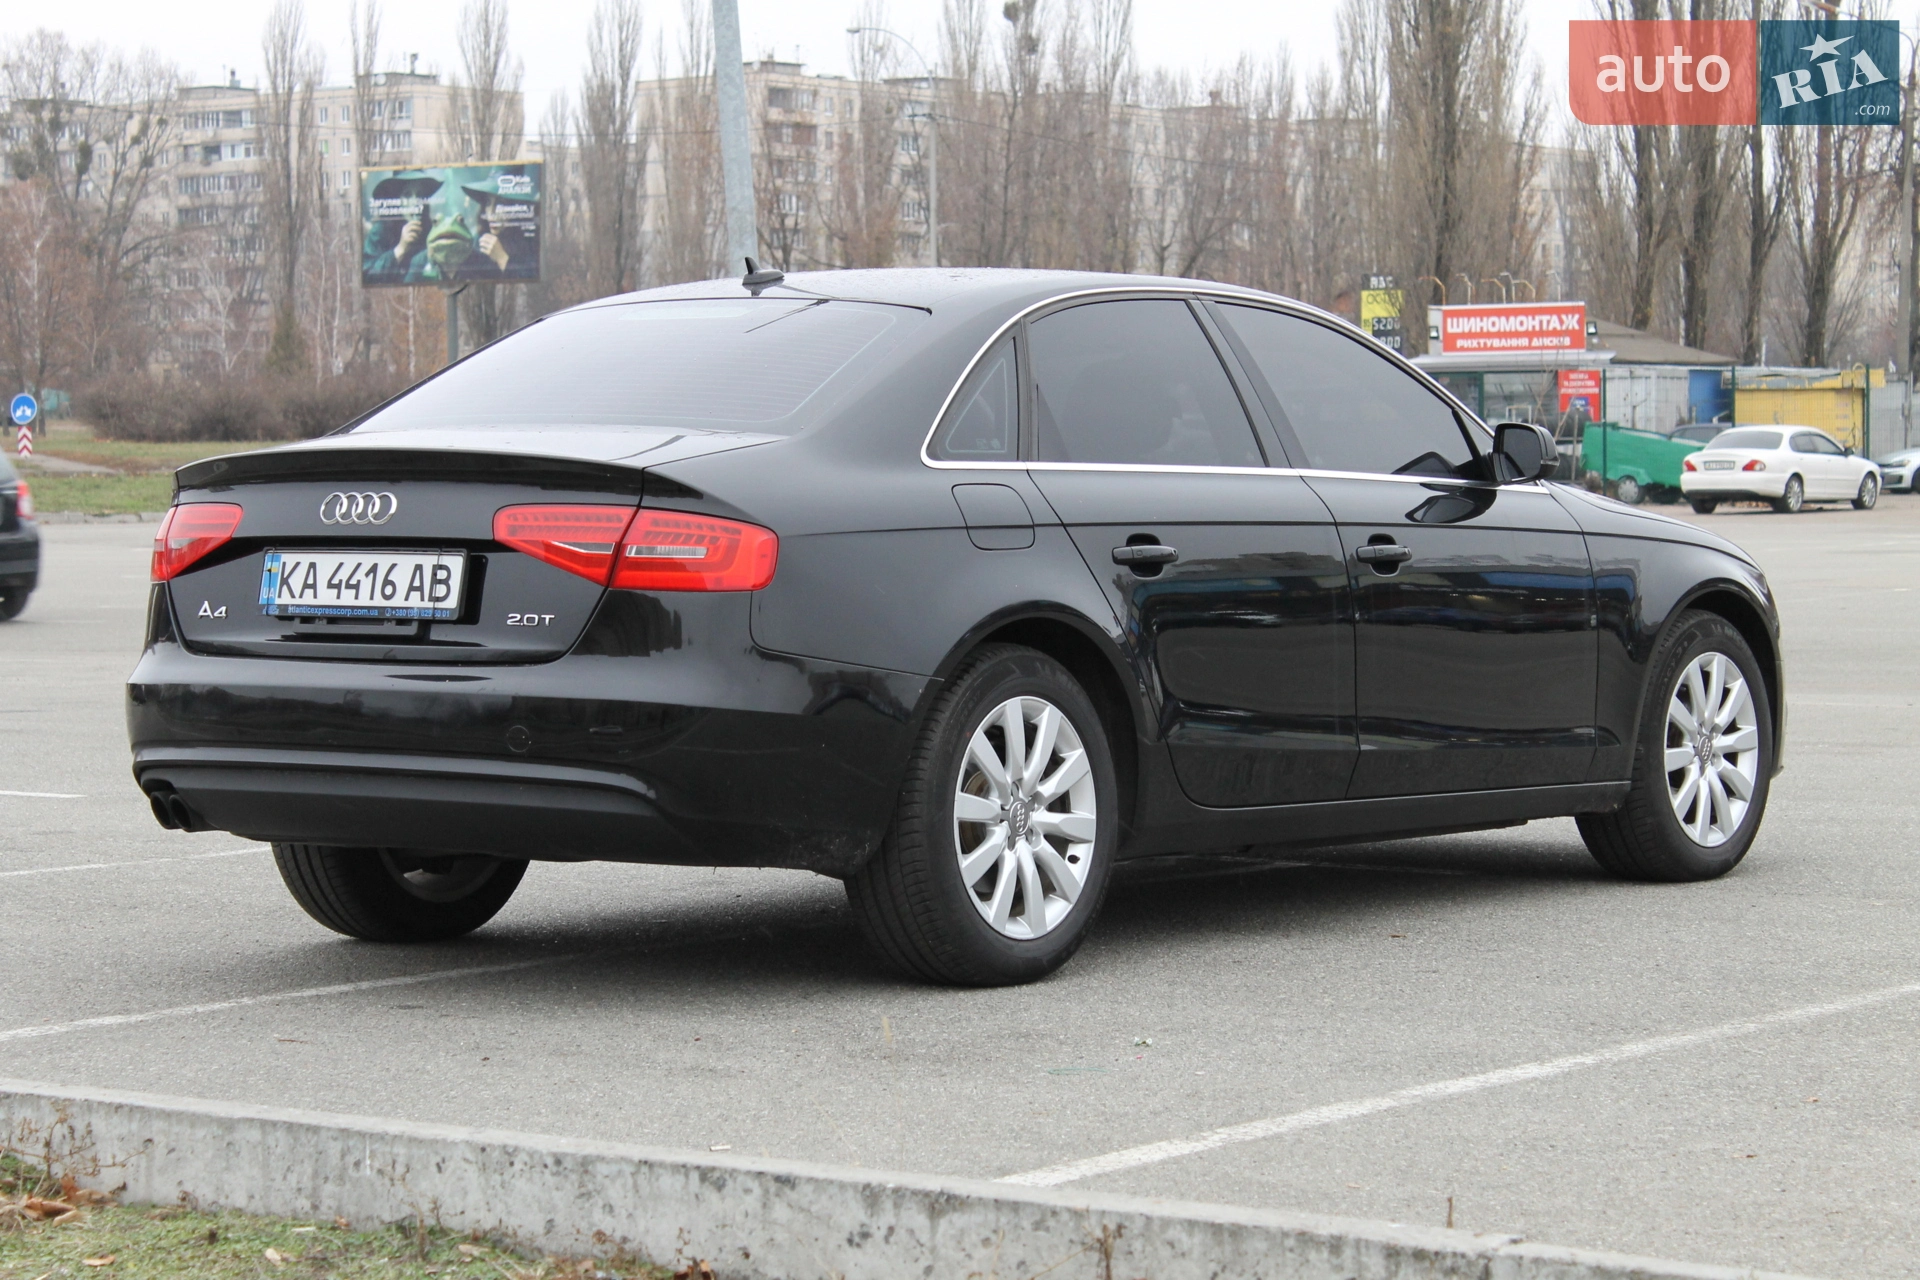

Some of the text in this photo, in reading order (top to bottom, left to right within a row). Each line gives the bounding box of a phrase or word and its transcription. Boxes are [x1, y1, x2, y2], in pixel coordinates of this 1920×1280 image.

[1446, 313, 1580, 334] ШИНОМОНТАЖ
[1456, 336, 1571, 349] РИХТУВАННЯ ДИСКІВ
[277, 561, 452, 603] KA 4416 AB
[197, 600, 228, 620] A4
[506, 613, 555, 626] 2.0T
